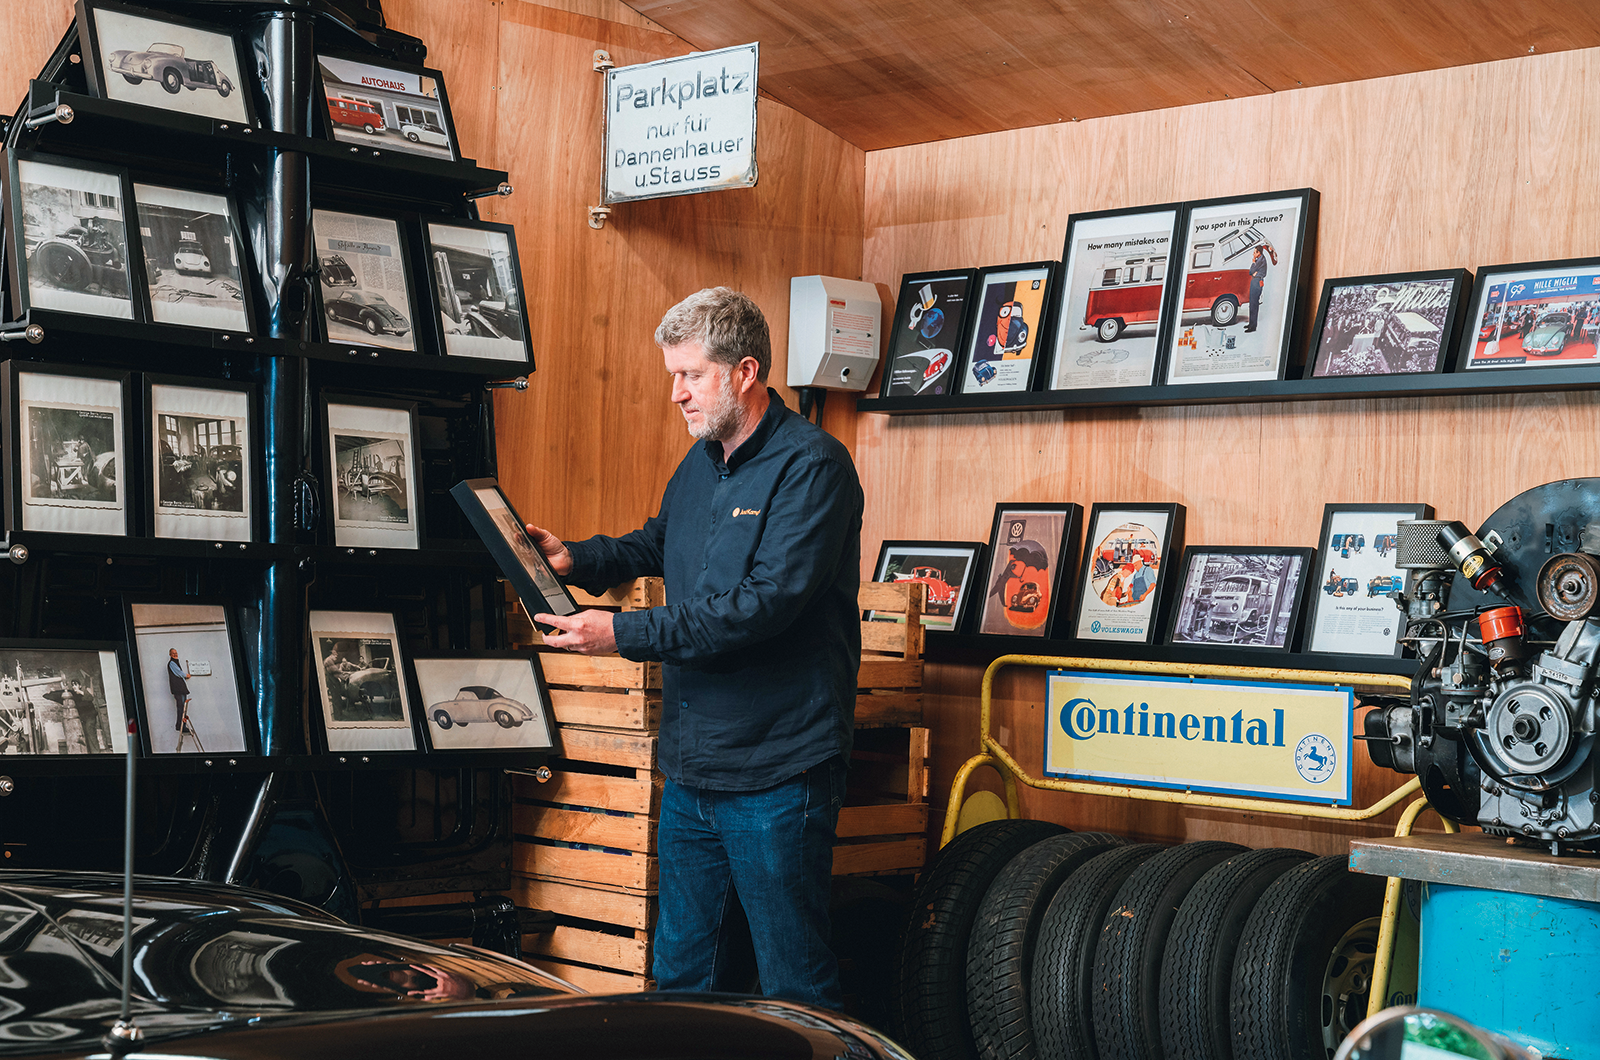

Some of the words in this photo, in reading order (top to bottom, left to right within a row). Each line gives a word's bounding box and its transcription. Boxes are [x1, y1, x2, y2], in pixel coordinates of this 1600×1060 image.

[361, 76, 406, 91] AUTOHAUS
[616, 66, 750, 112] Parkplatz
[647, 121, 680, 140] nur
[614, 137, 744, 168] Dannenhauer
[1195, 223, 1210, 233] you
[1211, 221, 1227, 231] spot
[1228, 219, 1236, 227] in
[1237, 217, 1251, 226] this
[1252, 213, 1284, 227] picture?
[1087, 243, 1104, 251] How
[1104, 241, 1124, 249] many
[1125, 237, 1155, 247] mistakes
[1534, 279, 1552, 290] MILLE
[1553, 276, 1578, 287] MIGLIA
[1101, 627, 1144, 635] VOLKSWAGEN
[1059, 697, 1287, 748] Continental
